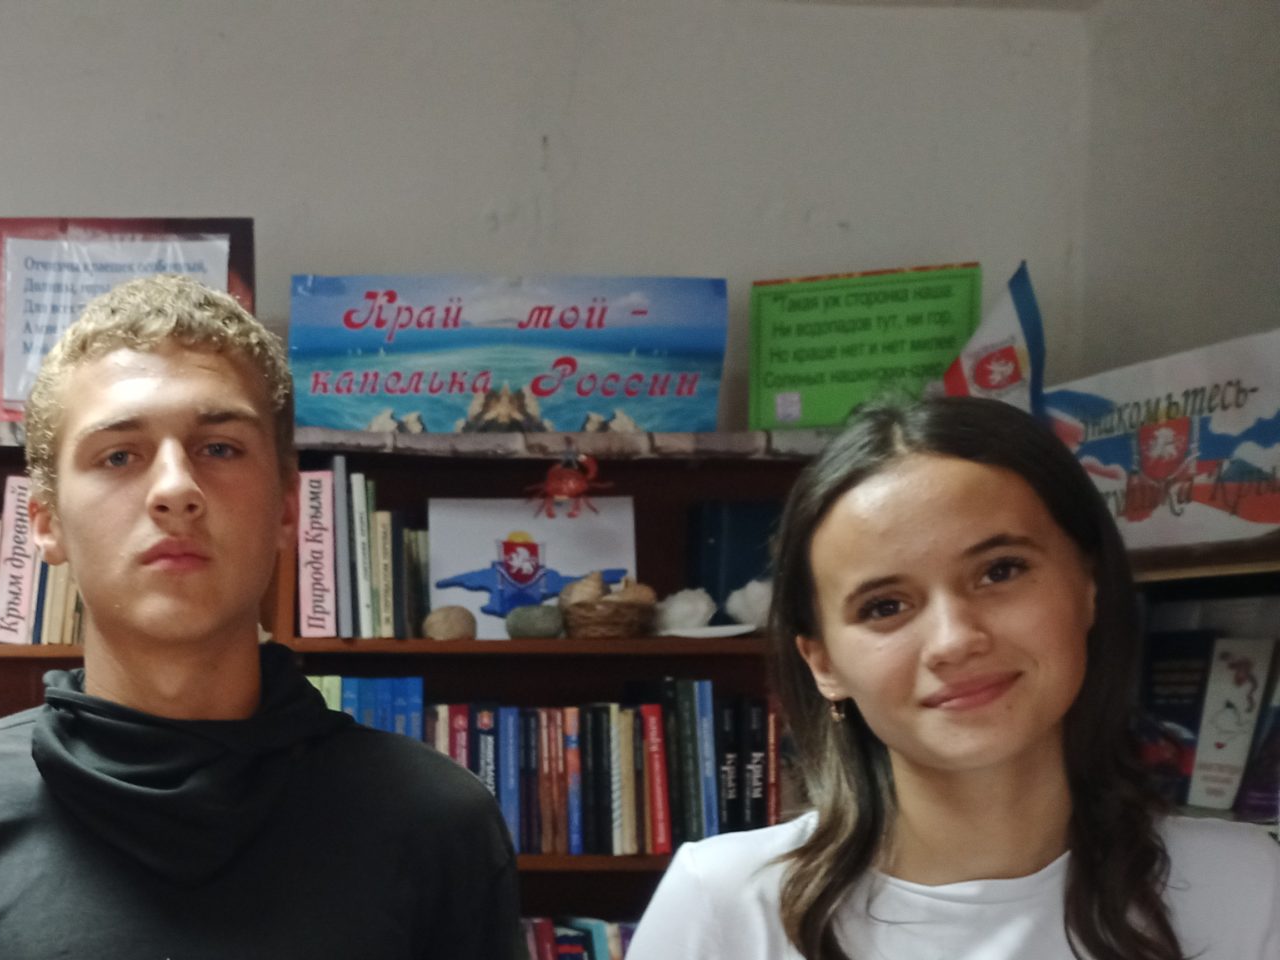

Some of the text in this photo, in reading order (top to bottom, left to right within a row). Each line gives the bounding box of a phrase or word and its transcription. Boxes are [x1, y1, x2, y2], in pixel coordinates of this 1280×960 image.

[343, 290, 463, 342] Край
[517, 297, 609, 330] мой
[310, 356, 700, 397] капелька России
[0, 484, 31, 635] Крым древний
[303, 479, 331, 630] Природа Крыма
